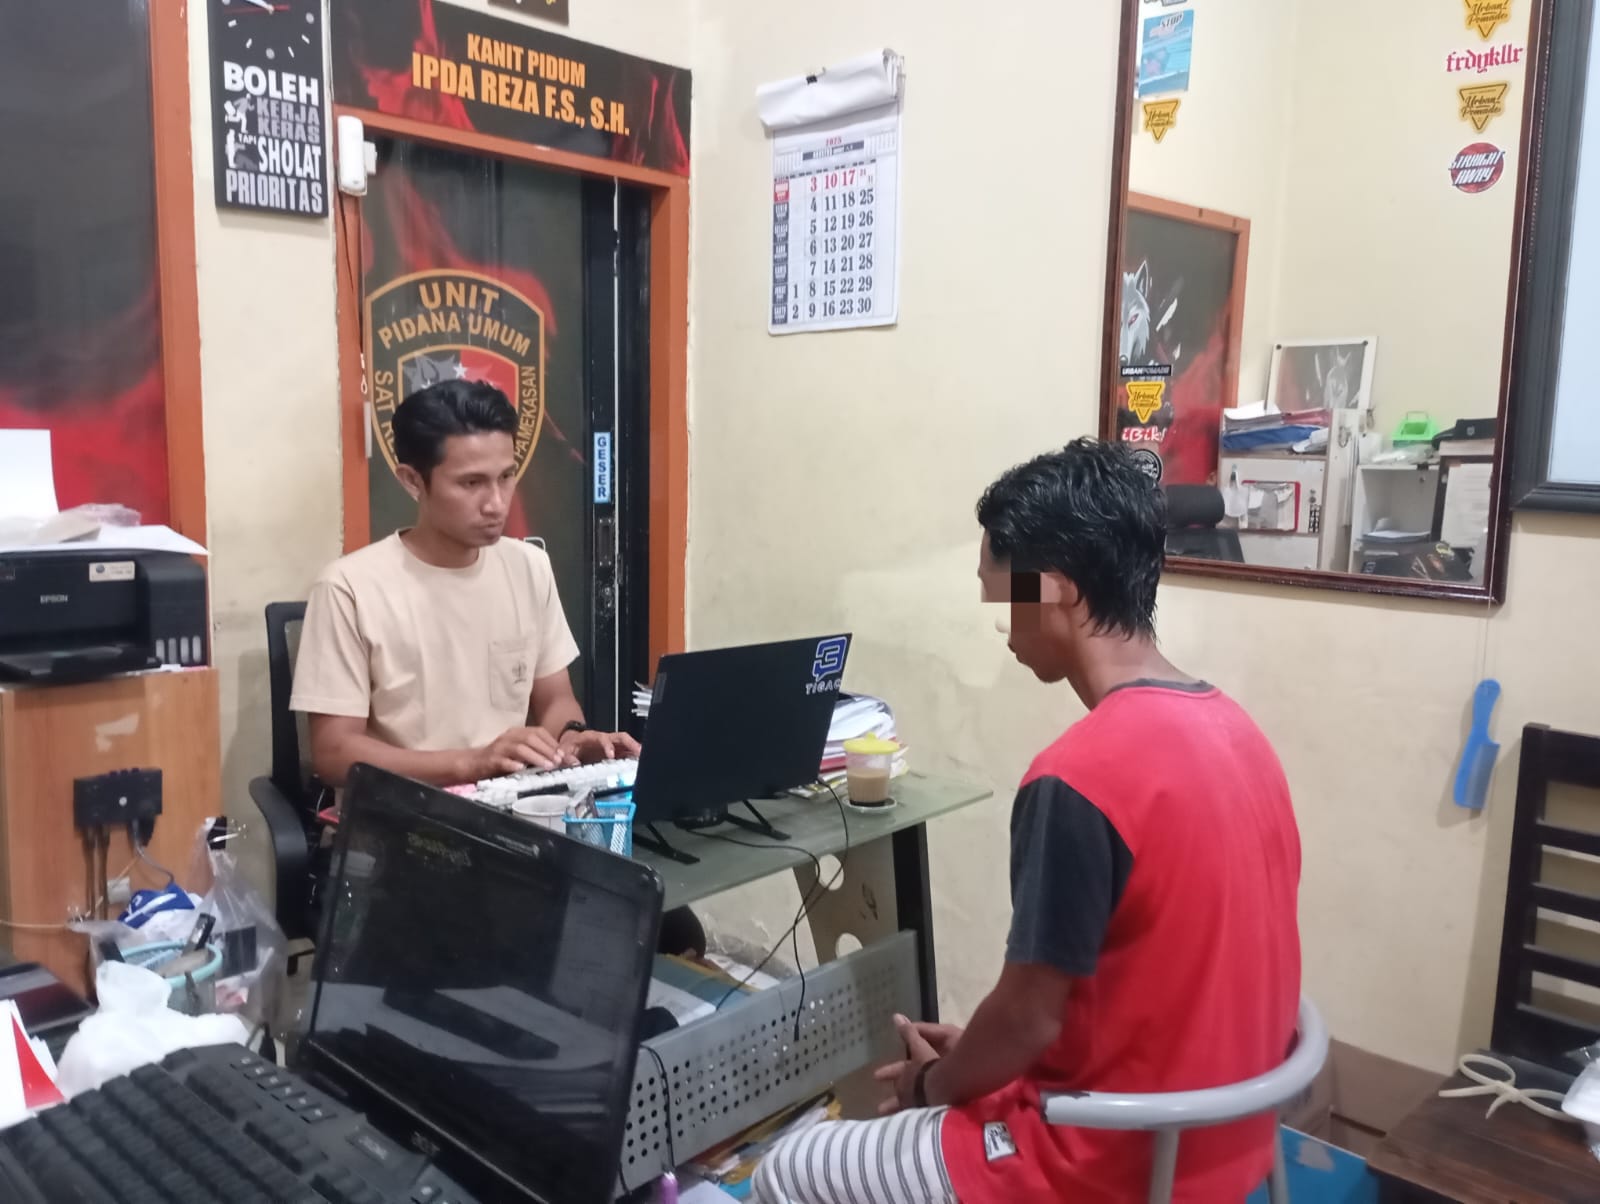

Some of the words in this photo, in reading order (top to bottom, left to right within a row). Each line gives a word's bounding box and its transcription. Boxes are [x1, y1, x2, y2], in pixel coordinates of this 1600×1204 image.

[468, 33, 524, 73] KANIT
[528, 50, 586, 88] PIDUM
[224, 60, 319, 106] BOLEH
[412, 52, 476, 100] IPDA
[480, 69, 540, 116] REZA
[545, 86, 585, 128] F.S.,
[590, 97, 630, 136] S.H.
[256, 97, 320, 126] KERJA
[238, 132, 257, 145] TAPI
[258, 116, 320, 144] KERAS
[258, 136, 322, 180] SHOLAT
[226, 168, 322, 213] PRIORITAS
[811, 177, 817, 193] 3
[825, 172, 837, 189] 10
[842, 170, 855, 186] 17
[810, 197, 816, 212] 4
[825, 195, 837, 211] 11
[842, 191, 855, 208] 18
[860, 189, 873, 205] 25
[810, 219, 816, 235] 5
[824, 216, 837, 232] 12
[841, 214, 854, 230] 19
[859, 211, 873, 227] 26
[810, 240, 816, 256] 6
[824, 238, 836, 253] 13
[841, 235, 854, 250] 20
[859, 233, 872, 248] 27
[810, 262, 816, 276] 7
[824, 259, 836, 274] 14
[841, 256, 853, 272] 21
[859, 254, 872, 270] 28
[418, 281, 500, 314] UNIT
[794, 285, 798, 299] 1
[809, 282, 816, 297] 8
[824, 280, 835, 296] 15
[840, 278, 854, 294] 22
[858, 276, 872, 292] 29
[792, 306, 799, 320] 2
[809, 303, 815, 318] 9
[823, 301, 835, 317] 16
[840, 300, 854, 316] 23
[858, 298, 871, 313] 30
[378, 312, 461, 349] PIDANA
[468, 314, 531, 357] UMUM
[375, 370, 395, 411] SAT
[598, 436, 606, 498] GESER
